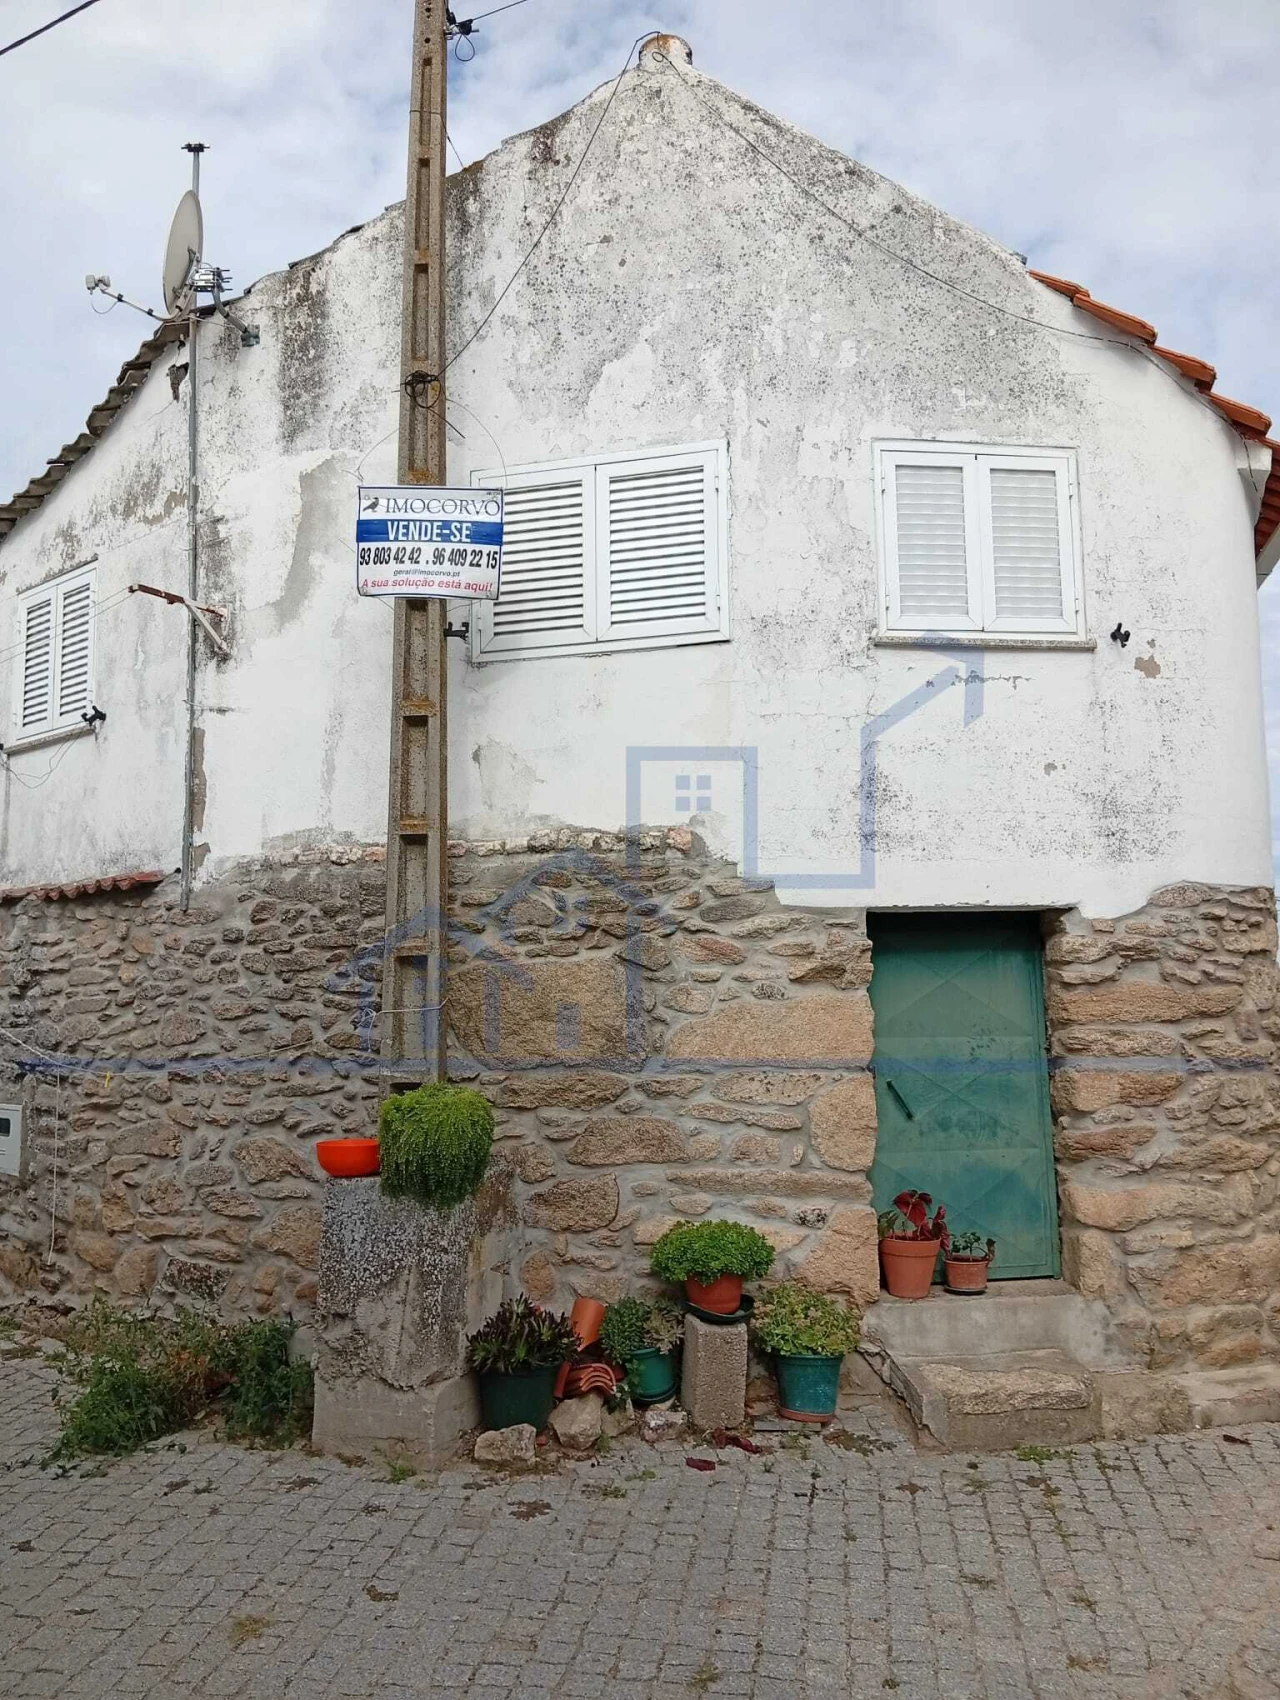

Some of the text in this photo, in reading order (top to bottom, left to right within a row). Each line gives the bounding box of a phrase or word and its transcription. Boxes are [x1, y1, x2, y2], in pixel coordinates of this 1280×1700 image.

[385, 497, 500, 516] IMOCORVO
[387, 520, 472, 542] VENDE-SE
[359, 547, 372, 566] 93
[372, 546, 392, 565] 803
[393, 546, 407, 565] 42
[408, 546, 422, 565] 42
[432, 547, 446, 566] 96
[447, 548, 468, 567] 409
[469, 549, 483, 568] 22
[486, 550, 499, 570] 15
[361, 577, 493, 593] A sua solução está aqui!
